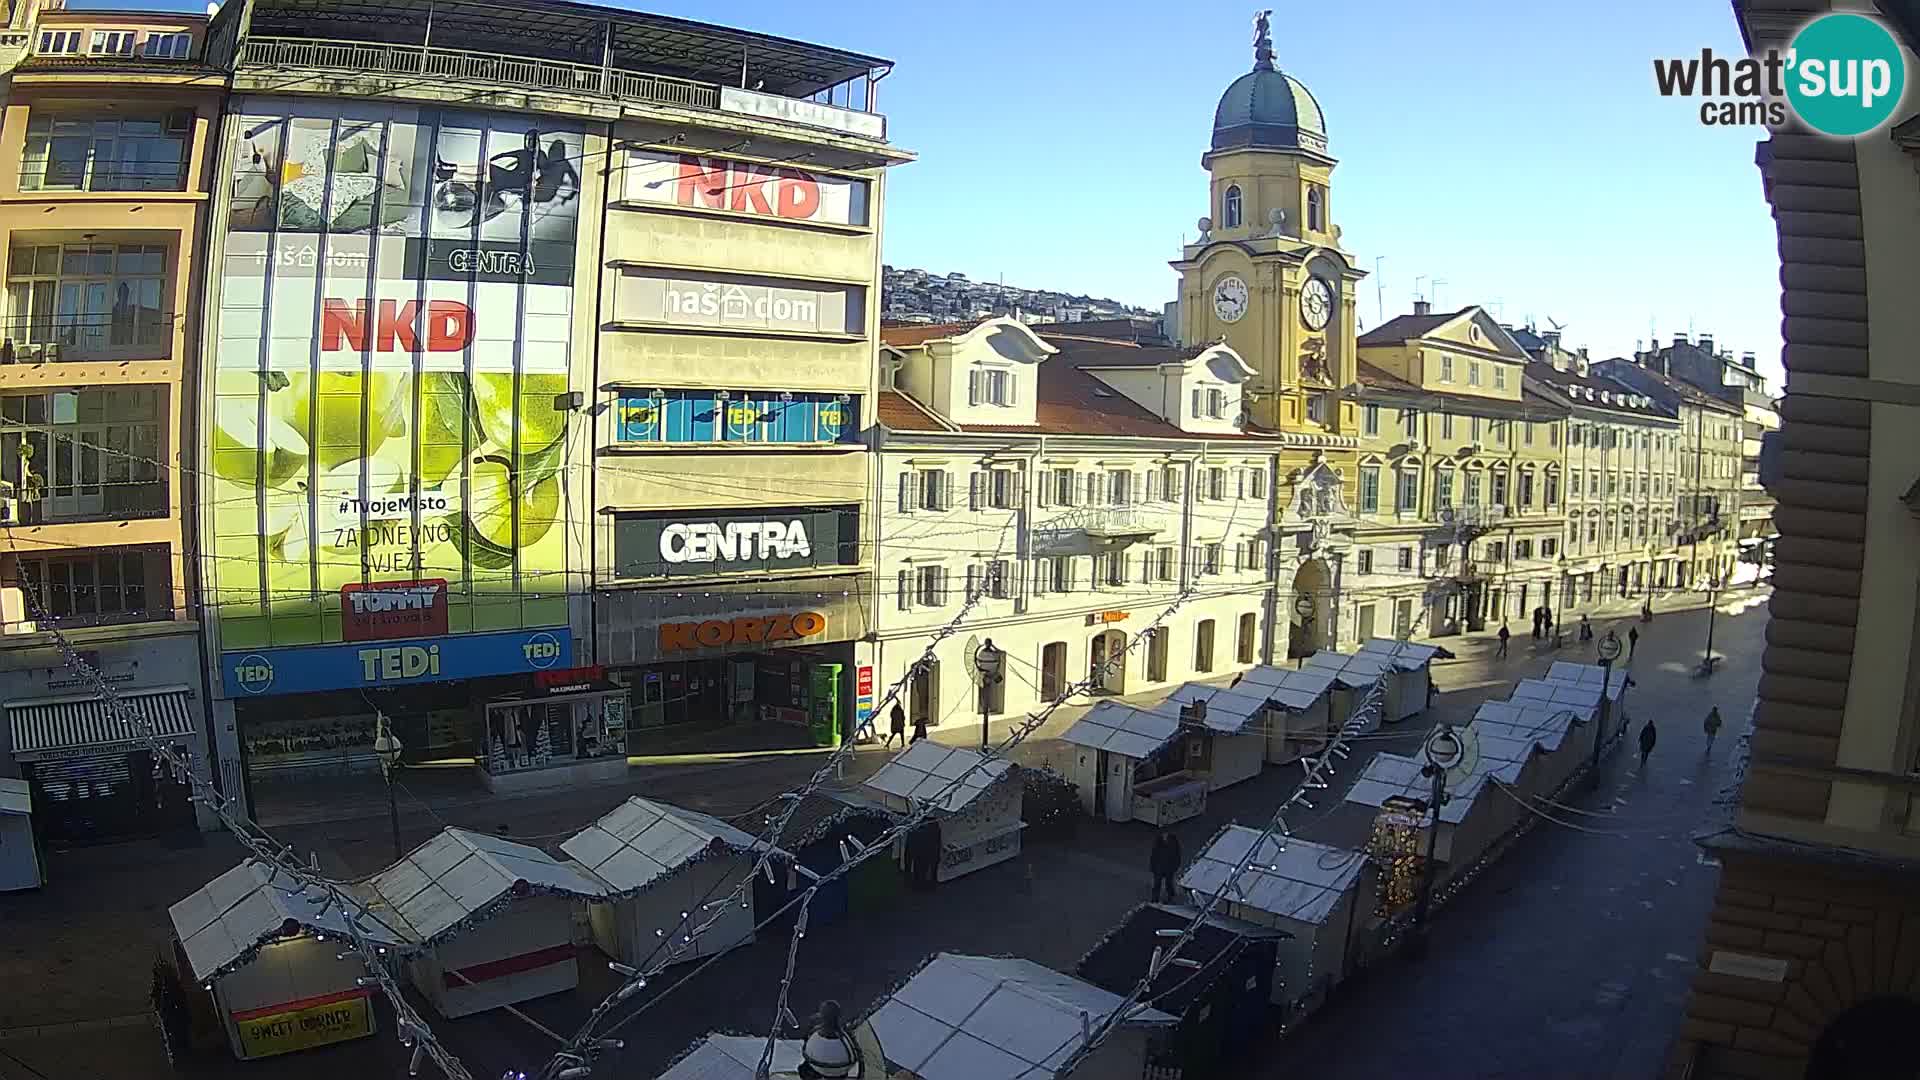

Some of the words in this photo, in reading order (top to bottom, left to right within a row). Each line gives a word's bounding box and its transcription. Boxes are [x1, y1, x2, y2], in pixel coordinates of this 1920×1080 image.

[677, 155, 821, 219] NKD
[448, 248, 537, 276] CENTRA
[665, 283, 719, 316] naš
[754, 287, 816, 322] dom
[321, 297, 477, 353] NKD
[659, 519, 812, 563] CENTRA
[350, 584, 440, 614] TOMMY
[658, 611, 826, 650] KORZO
[358, 644, 441, 681] TEDi
[523, 642, 561, 659] TEDi
[234, 665, 274, 683] TEDi
